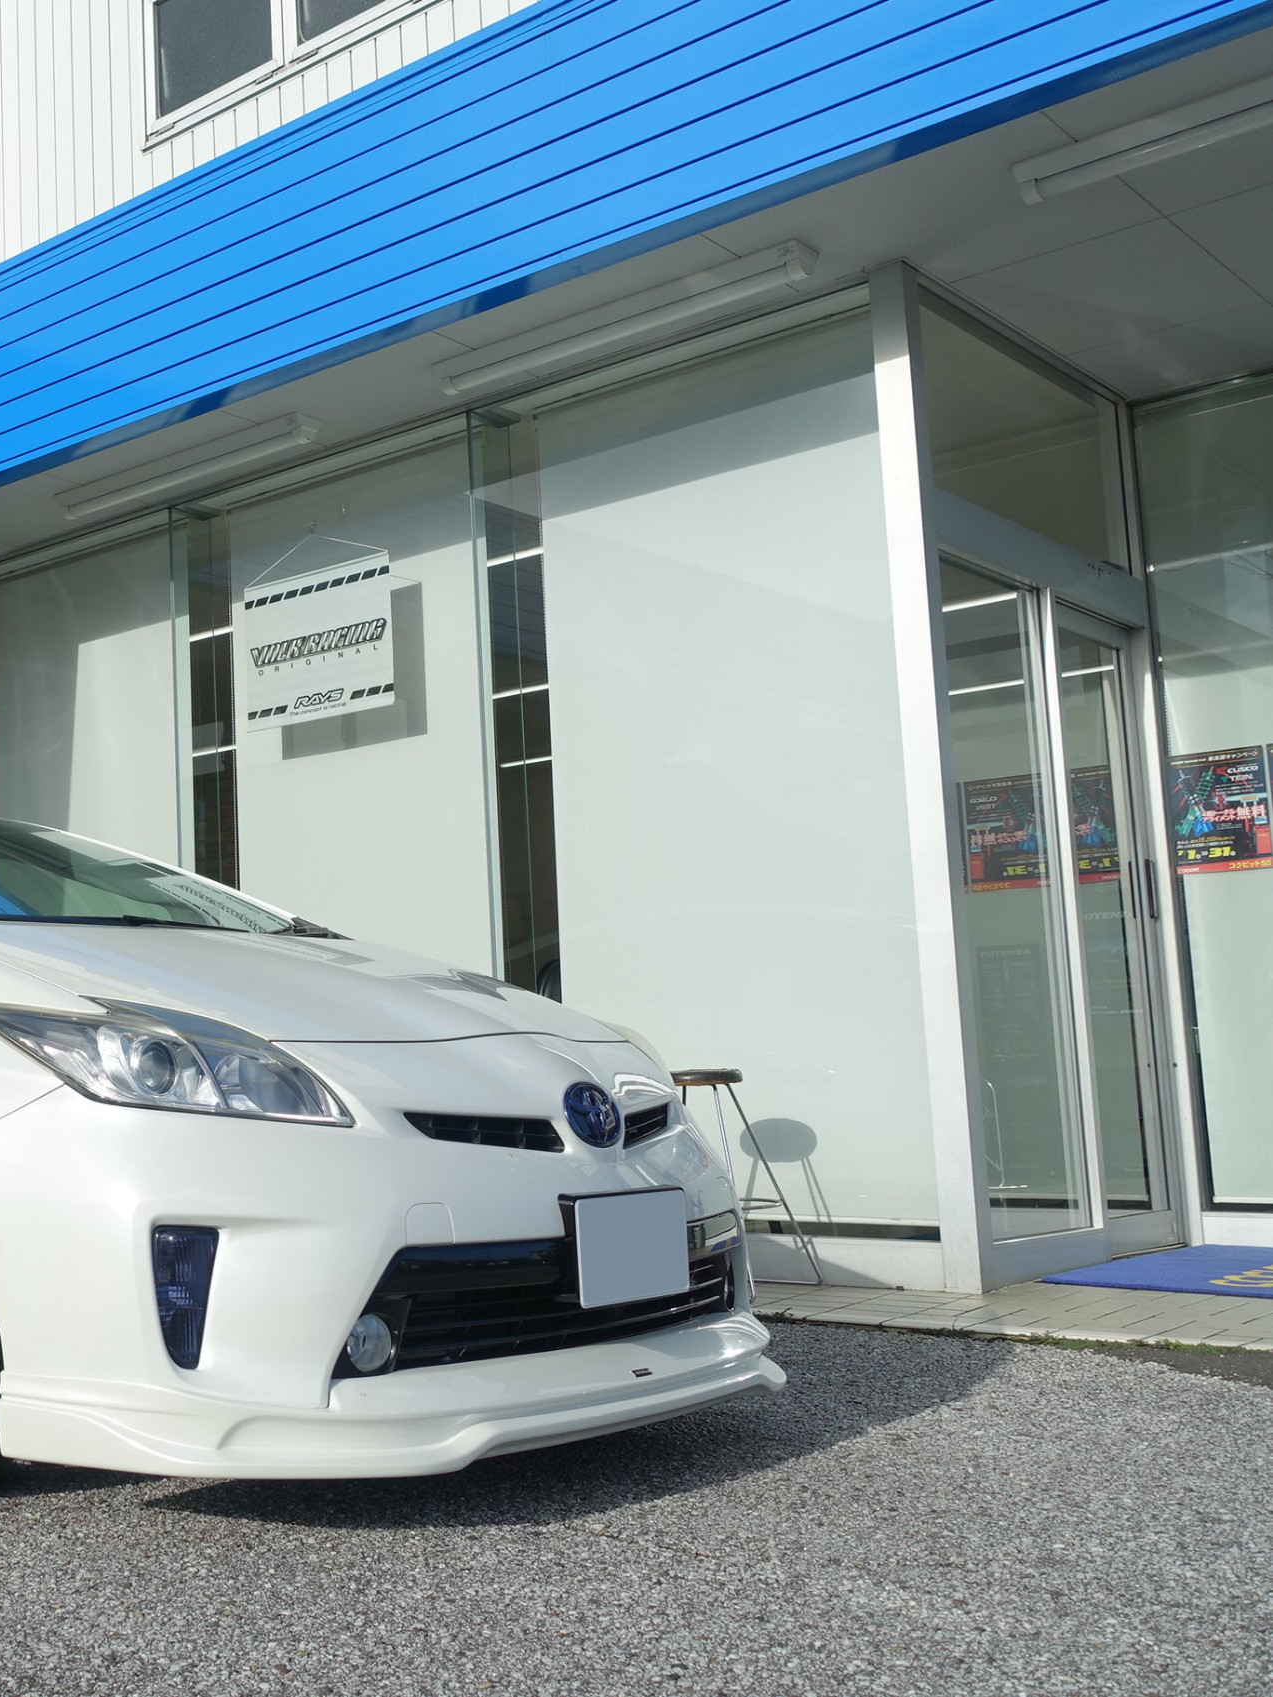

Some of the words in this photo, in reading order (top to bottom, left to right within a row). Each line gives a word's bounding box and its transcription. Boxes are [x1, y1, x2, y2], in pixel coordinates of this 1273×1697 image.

[302, 618, 387, 658] RACING
[258, 644, 378, 676] ORIGINAL
[294, 688, 344, 709] RAYS
[1227, 765, 1259, 774] CUSCO
[1236, 804, 1266, 820] 無料
